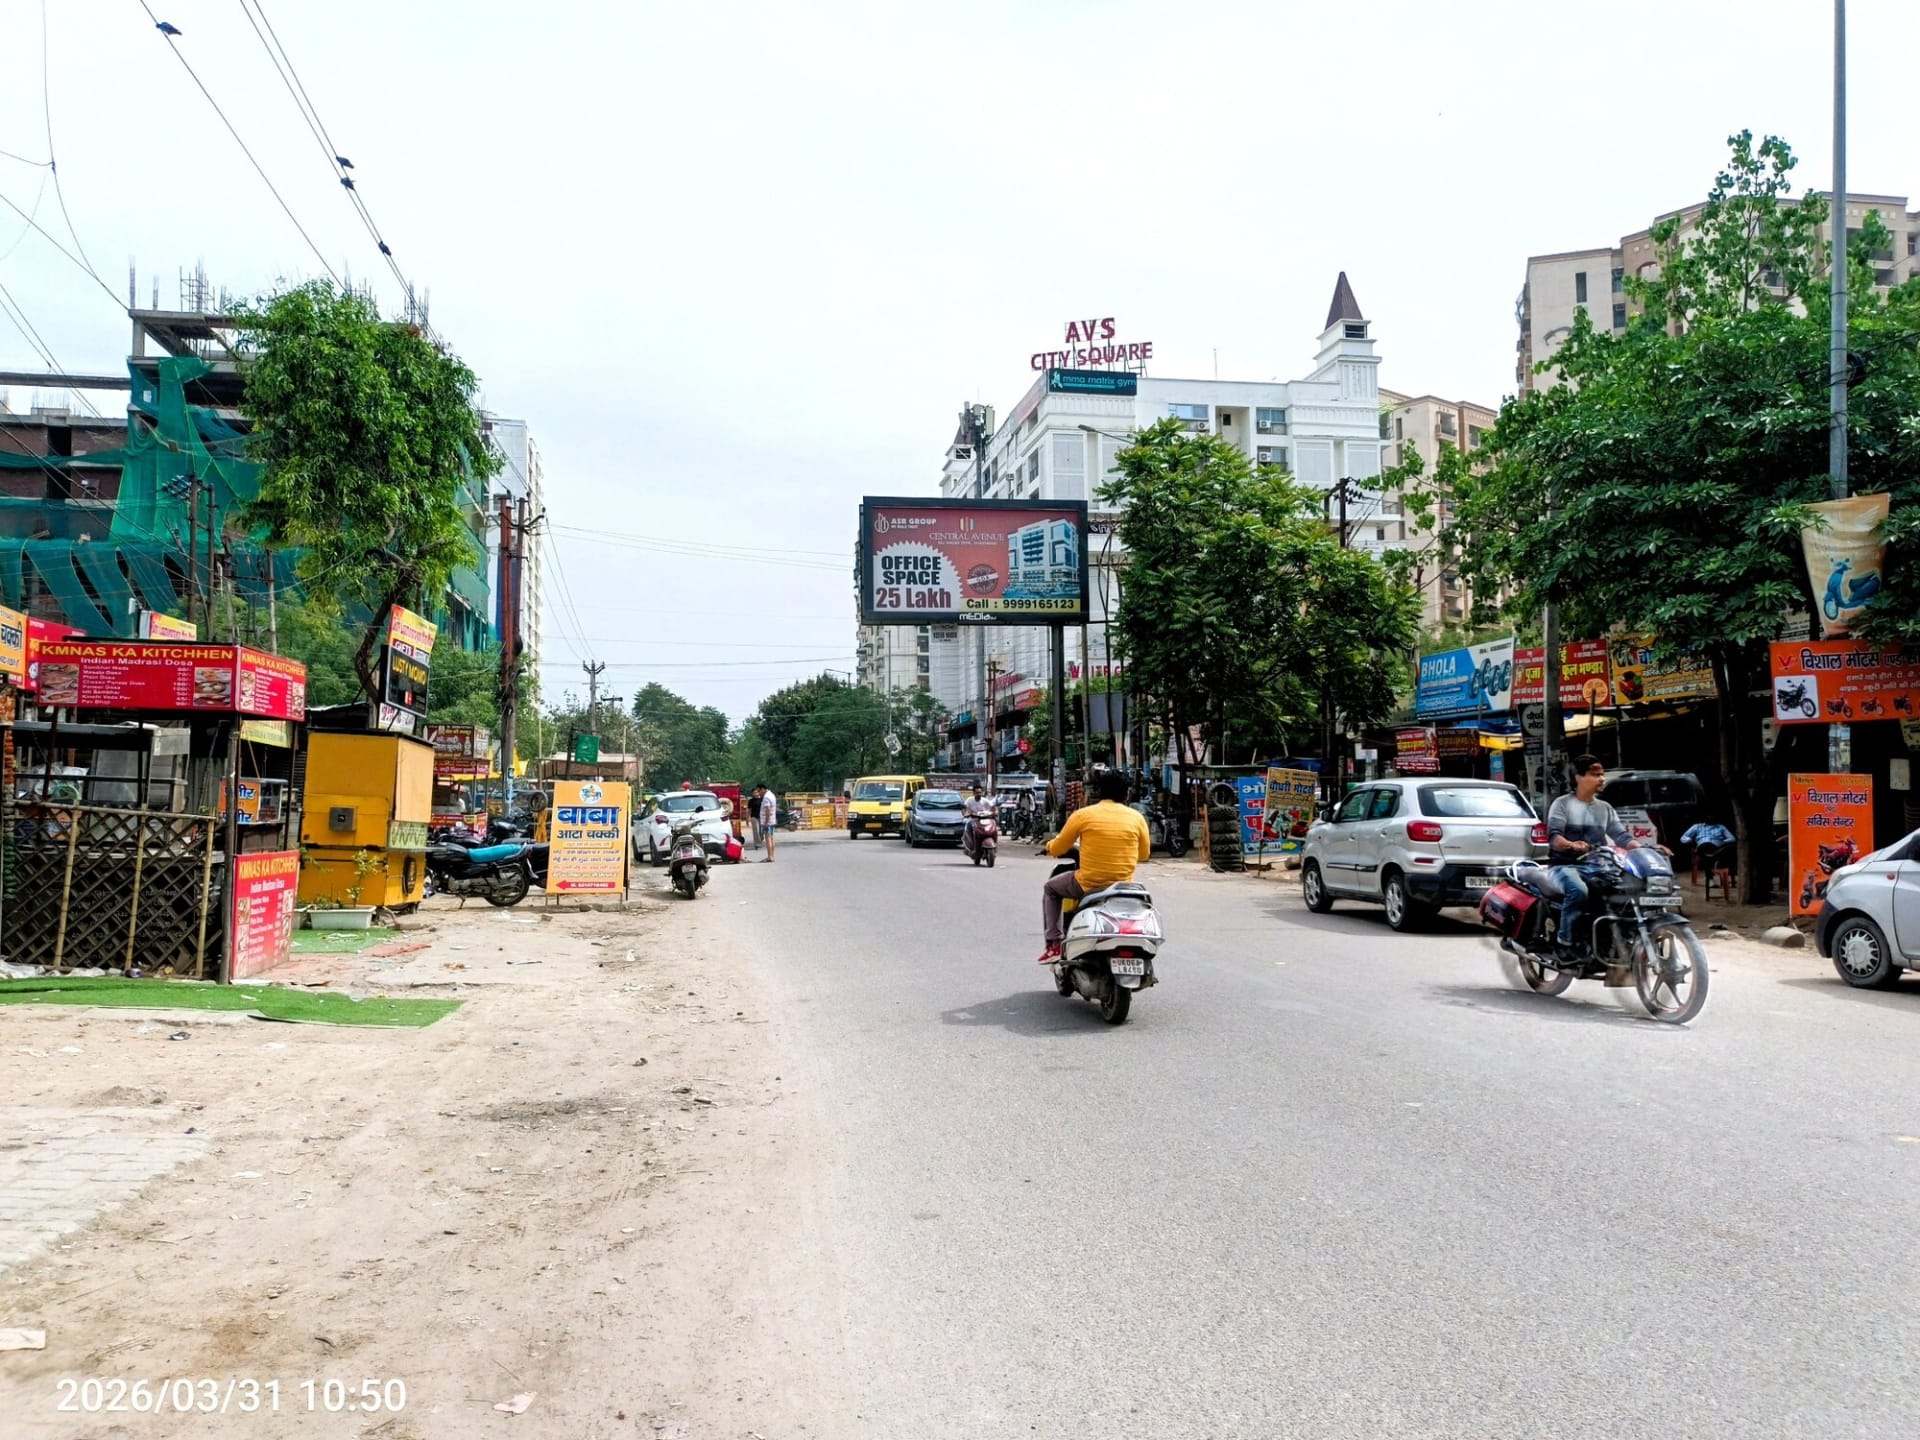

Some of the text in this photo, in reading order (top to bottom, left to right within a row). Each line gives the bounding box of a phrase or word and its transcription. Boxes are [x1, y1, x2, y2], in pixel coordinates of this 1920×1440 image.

[1065, 317, 1115, 343] AVS
[1030, 342, 1152, 371] CITY SQUARE
[1088, 376, 1115, 384] matrix
[1117, 379, 1136, 388] gym
[929, 532, 1004, 541] CENTRAL AVENUE
[882, 556, 942, 570] OFFICE
[882, 570, 940, 586] SPACE
[876, 587, 952, 608] 25 Lakh
[966, 598, 989, 608] Call
[1003, 599, 1074, 609] 9999165123
[42, 646, 234, 660] KMNAS KA KITCHHEN
[1800, 648, 1842, 670] विशाल
[118, 658, 162, 666] Madrasi
[1422, 656, 1456, 678] BHOLA
[408, 662, 426, 686] MOMO
[1525, 667, 1541, 684] पूजा
[1562, 664, 1578, 681] फूल
[1808, 788, 1869, 805] विशाल मोटर्स
[557, 806, 620, 826] बाबा
[1806, 814, 1830, 827] सर्विस
[557, 827, 620, 839] आटा चक्की
